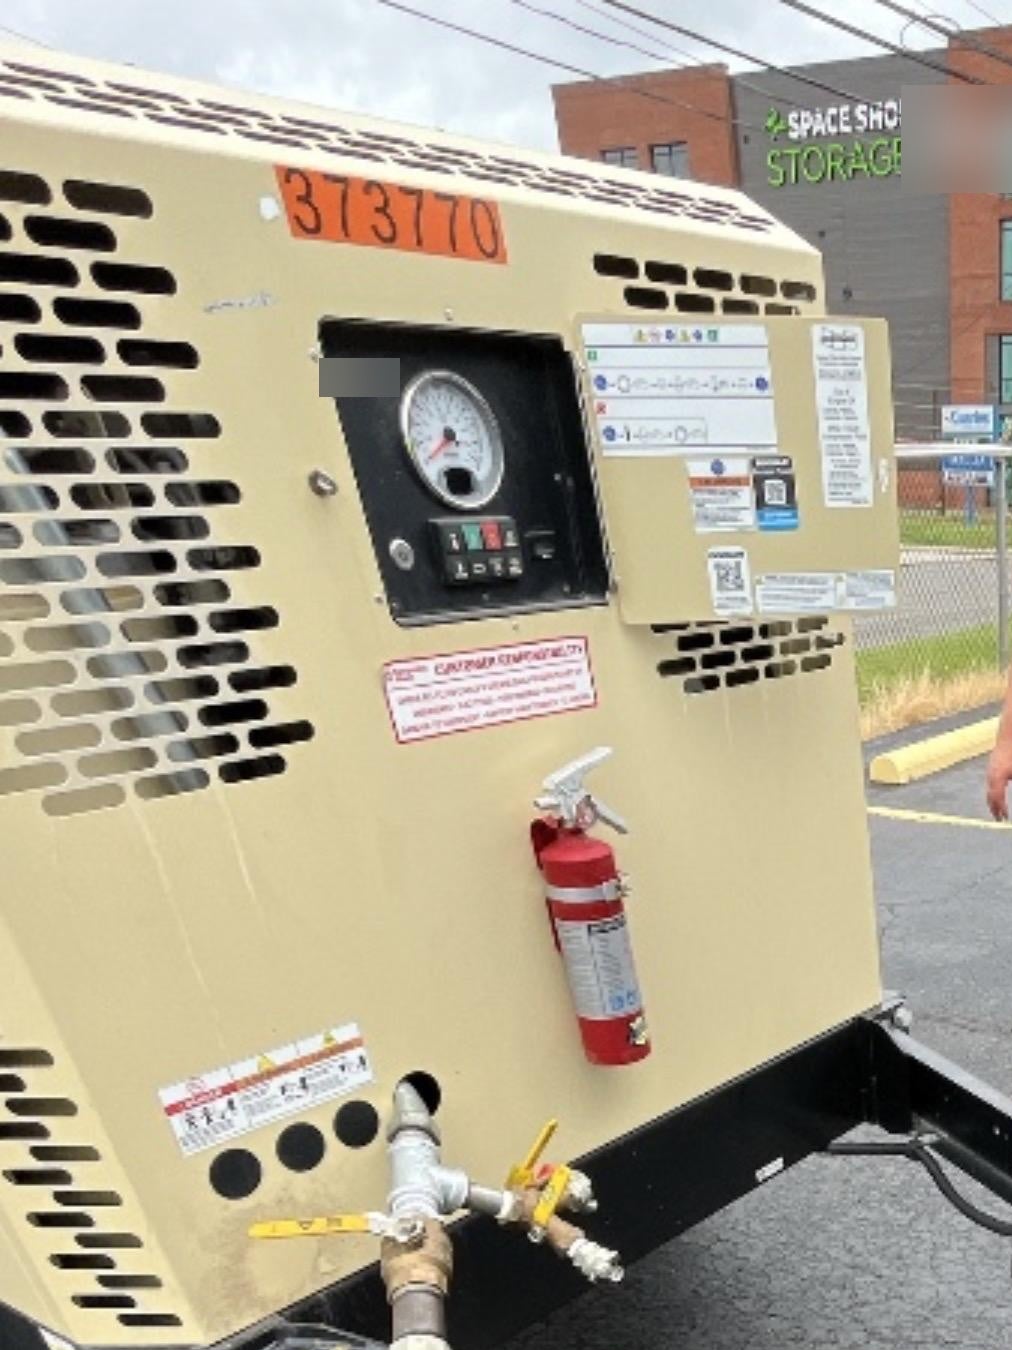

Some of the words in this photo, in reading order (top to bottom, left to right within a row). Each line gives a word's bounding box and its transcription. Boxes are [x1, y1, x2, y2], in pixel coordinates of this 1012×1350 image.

[788, 104, 853, 139] SPACE
[855, 98, 902, 132] SHO
[284, 167, 499, 259] 373770
